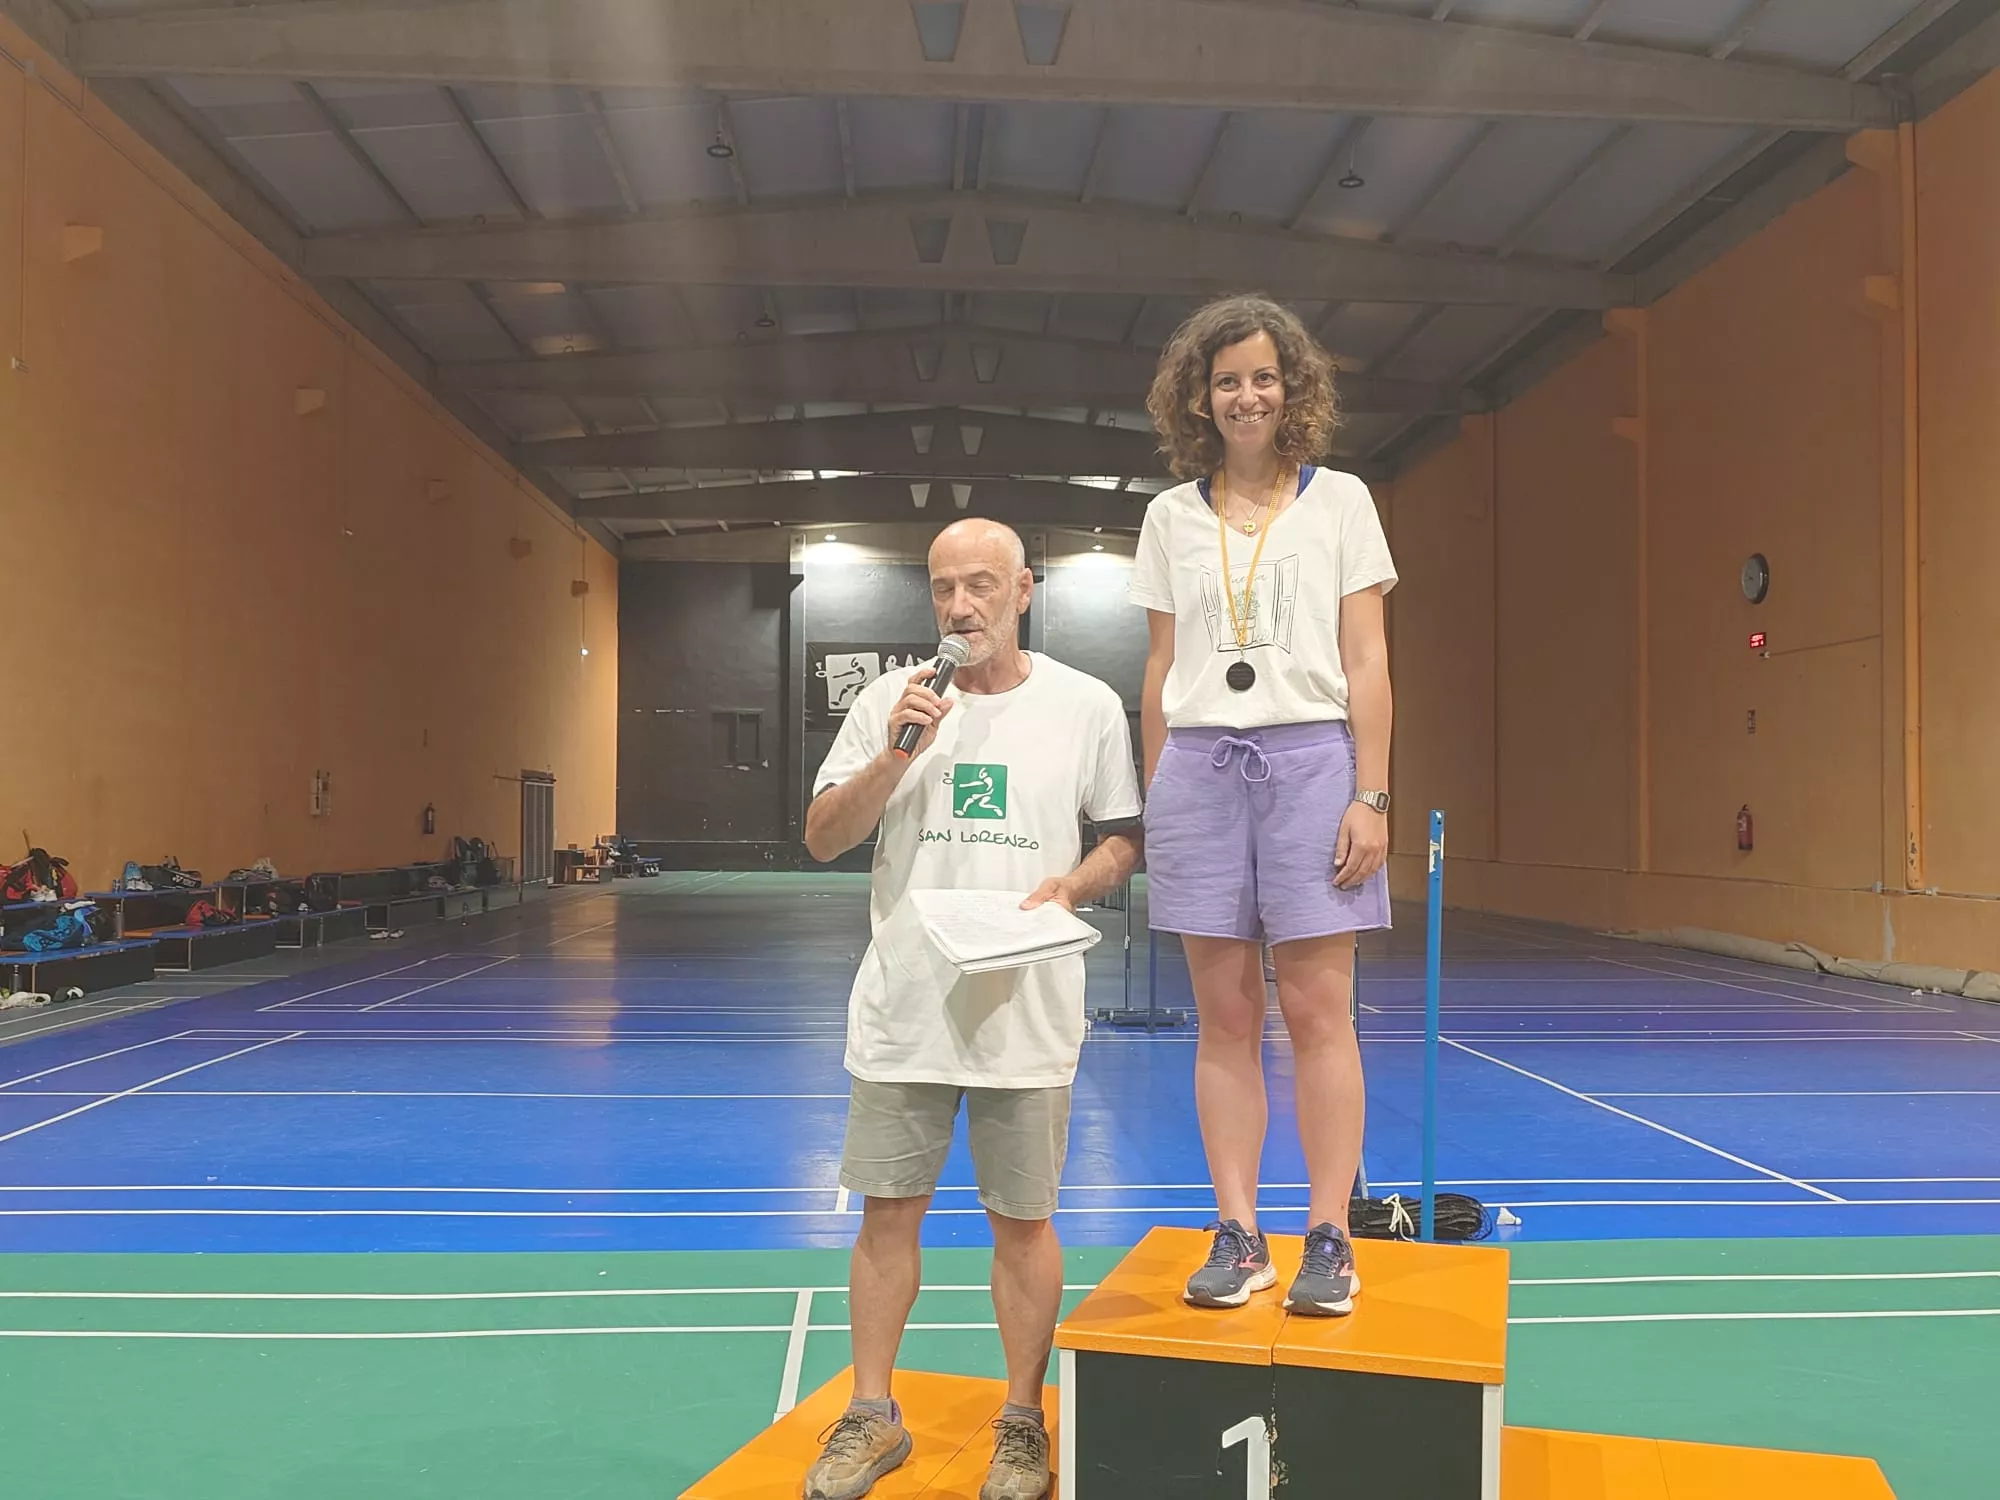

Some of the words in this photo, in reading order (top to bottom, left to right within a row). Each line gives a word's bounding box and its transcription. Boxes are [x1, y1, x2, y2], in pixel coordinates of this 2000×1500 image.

[918, 828, 952, 843] SAN
[960, 829, 1040, 850] LORENZO
[1221, 1415, 1270, 1500] 1
